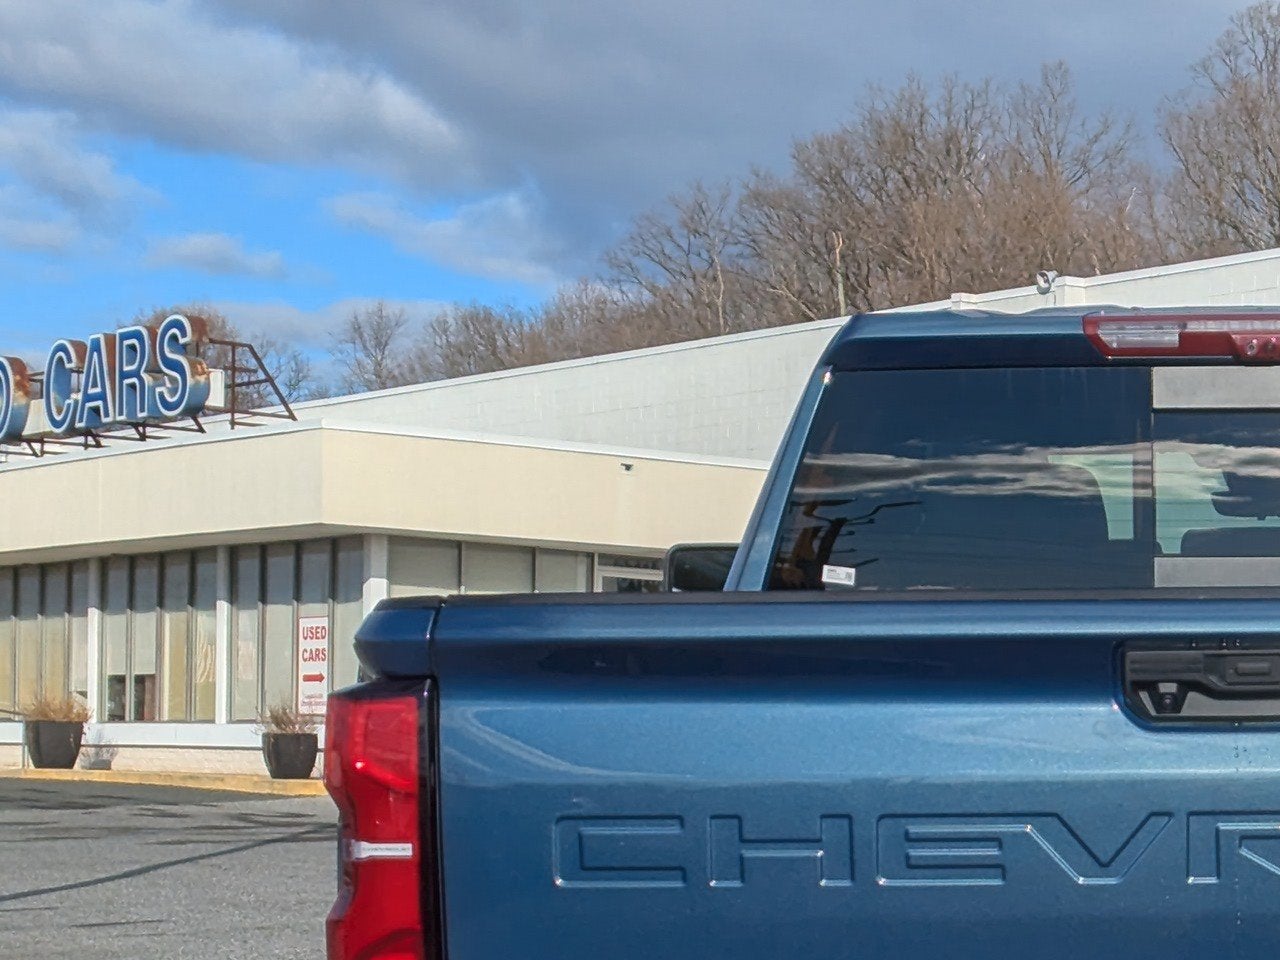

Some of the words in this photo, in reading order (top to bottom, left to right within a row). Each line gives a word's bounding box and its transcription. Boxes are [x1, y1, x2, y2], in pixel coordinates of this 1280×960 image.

[44, 314, 192, 433] CARS
[302, 625, 327, 641] USED
[302, 647, 327, 663] CARS
